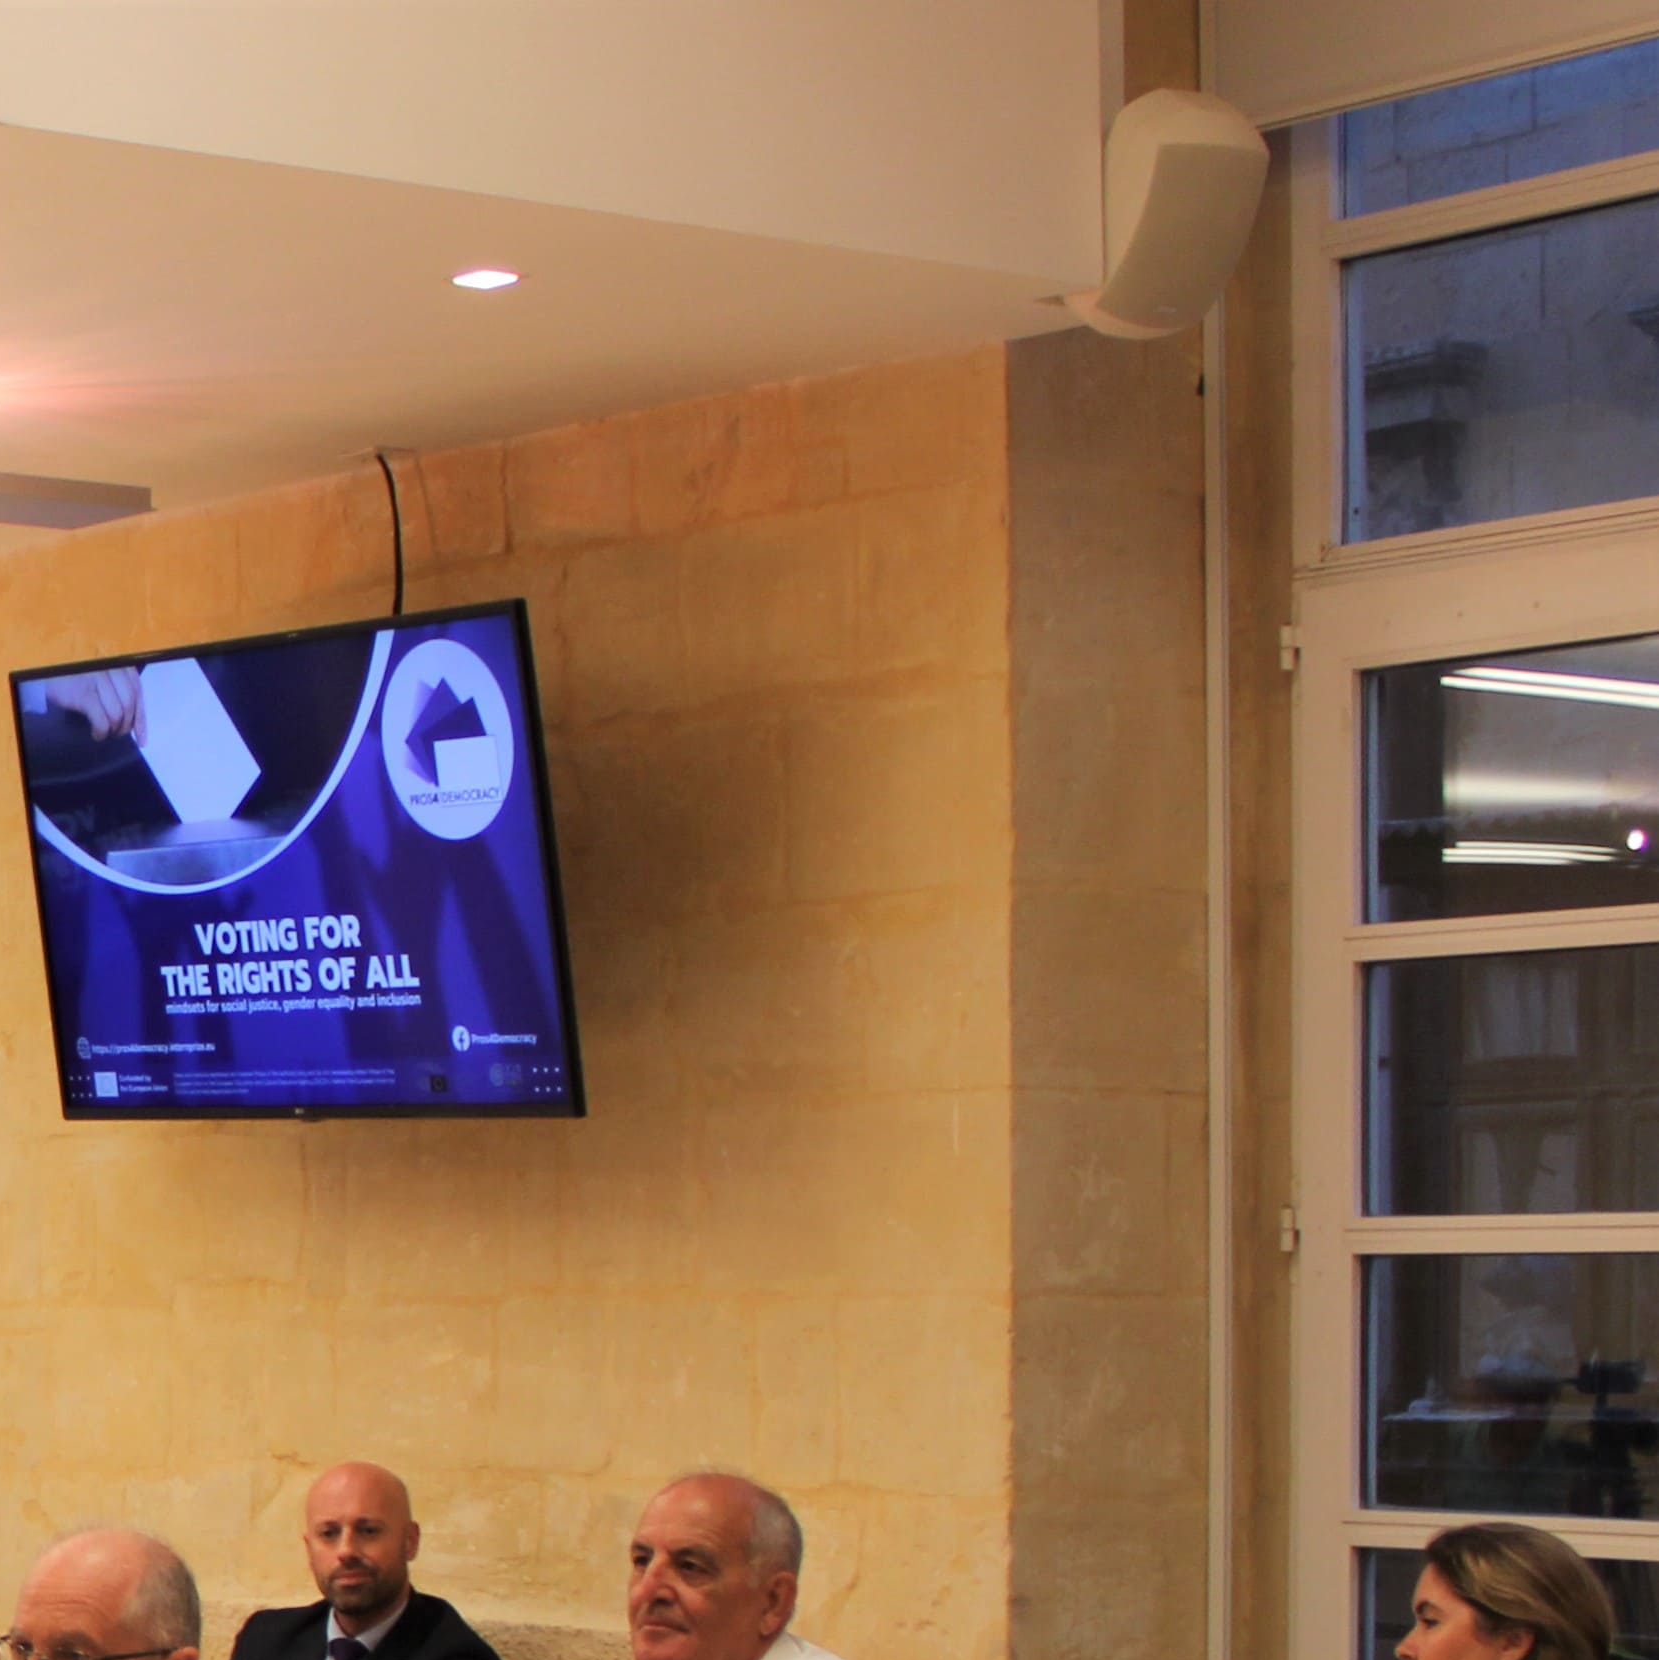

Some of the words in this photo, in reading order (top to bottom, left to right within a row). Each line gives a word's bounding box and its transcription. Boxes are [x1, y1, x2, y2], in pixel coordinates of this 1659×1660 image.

[194, 917, 299, 955] VOTING
[303, 915, 361, 950] FOR
[160, 964, 212, 997] THE
[216, 958, 313, 995] RIGHTS
[318, 956, 356, 990] OF
[366, 954, 421, 989] ALL
[166, 1001, 205, 1014] mindsets
[206, 1000, 219, 1012] for
[221, 999, 248, 1012] social
[283, 998, 316, 1013] gender
[317, 995, 355, 1011] equality
[357, 995, 375, 1007] and
[377, 993, 422, 1006] inclusion
